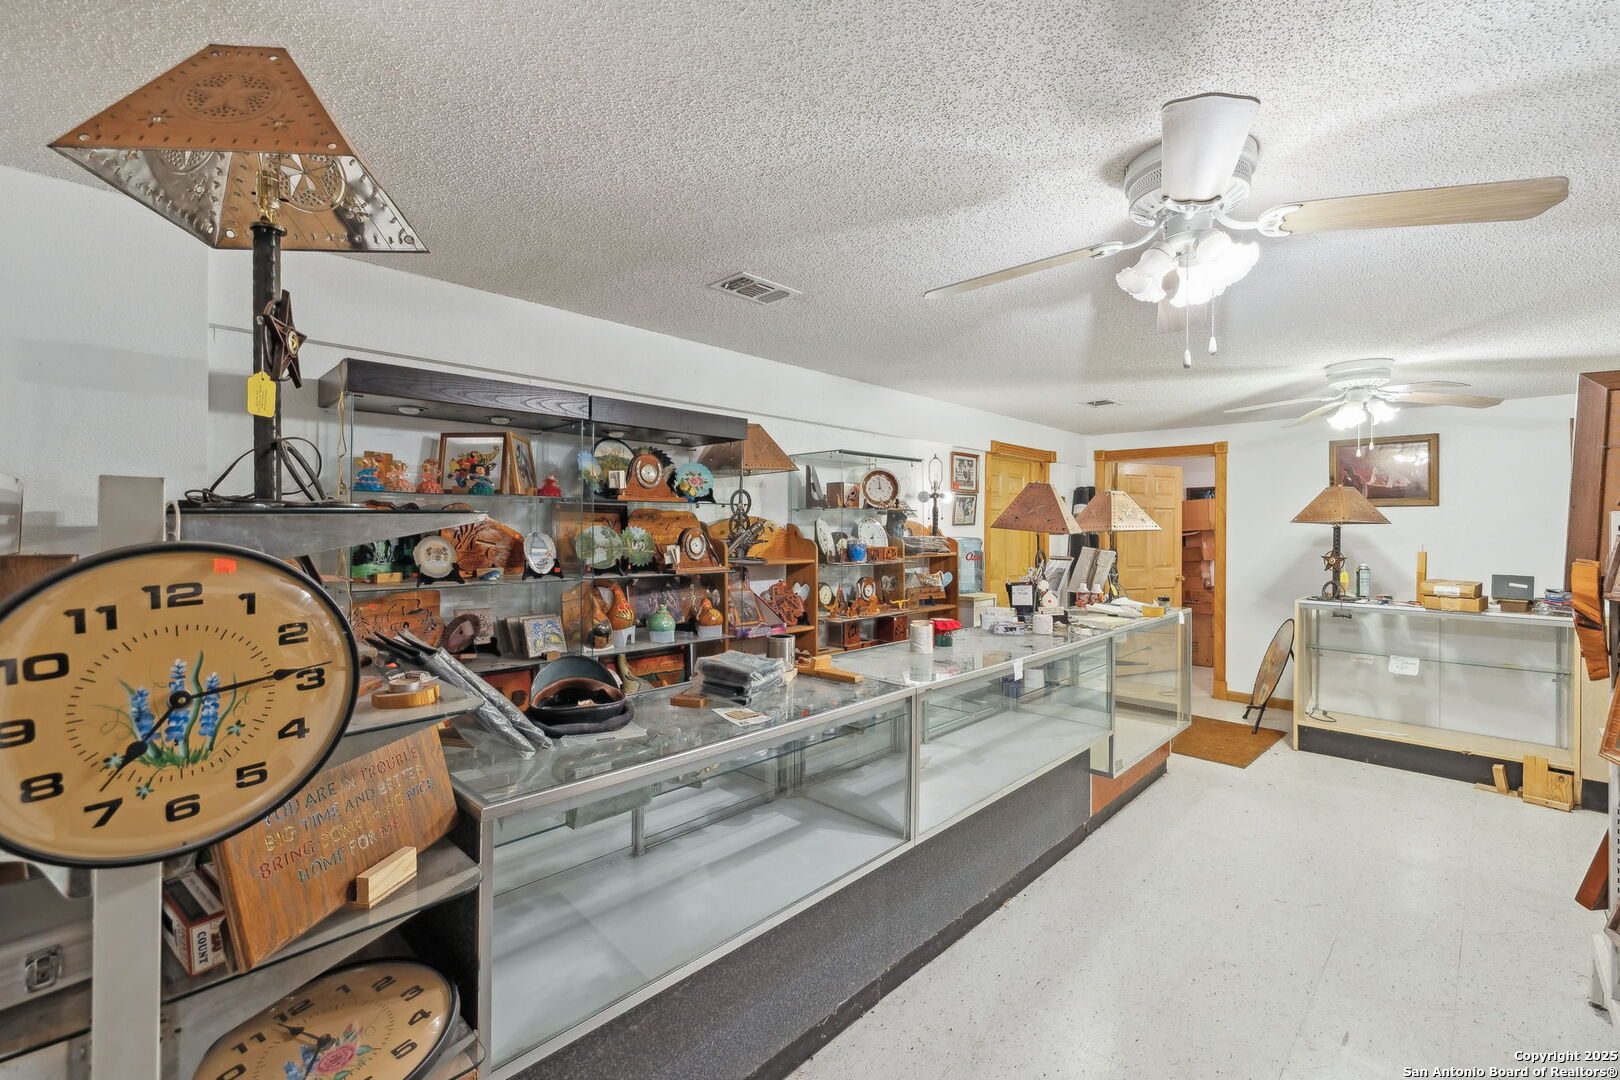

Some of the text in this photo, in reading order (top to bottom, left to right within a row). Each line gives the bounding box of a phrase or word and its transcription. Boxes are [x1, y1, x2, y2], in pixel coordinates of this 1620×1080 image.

[141, 582, 204, 610] 12
[238, 592, 256, 615] 1
[63, 605, 117, 634] 11
[278, 622, 309, 646] 2
[0, 652, 69, 686] 10
[296, 667, 326, 691] 3
[0, 718, 36, 748] 9
[277, 717, 310, 740] 4
[19, 772, 64, 804] 8
[236, 761, 268, 789] 5
[305, 782, 338, 808] ARE
[340, 776, 358, 792] IN
[360, 746, 419, 781] TROUBLE
[83, 797, 123, 829] 7
[165, 794, 200, 822] 6
[264, 763, 424, 852] BIG TIME AND BETTER
[259, 776, 435, 881] BRING SOMETHING NICE
[298, 816, 402, 883] HOME FOR ME
[197, 930, 209, 964] COUNT
[335, 984, 351, 995] 1
[372, 975, 397, 992] 2
[400, 985, 424, 1002] 3
[272, 999, 315, 1023] 12
[408, 1008, 432, 1026] 4
[231, 1032, 267, 1054] 11
[390, 1038, 418, 1060] 5
